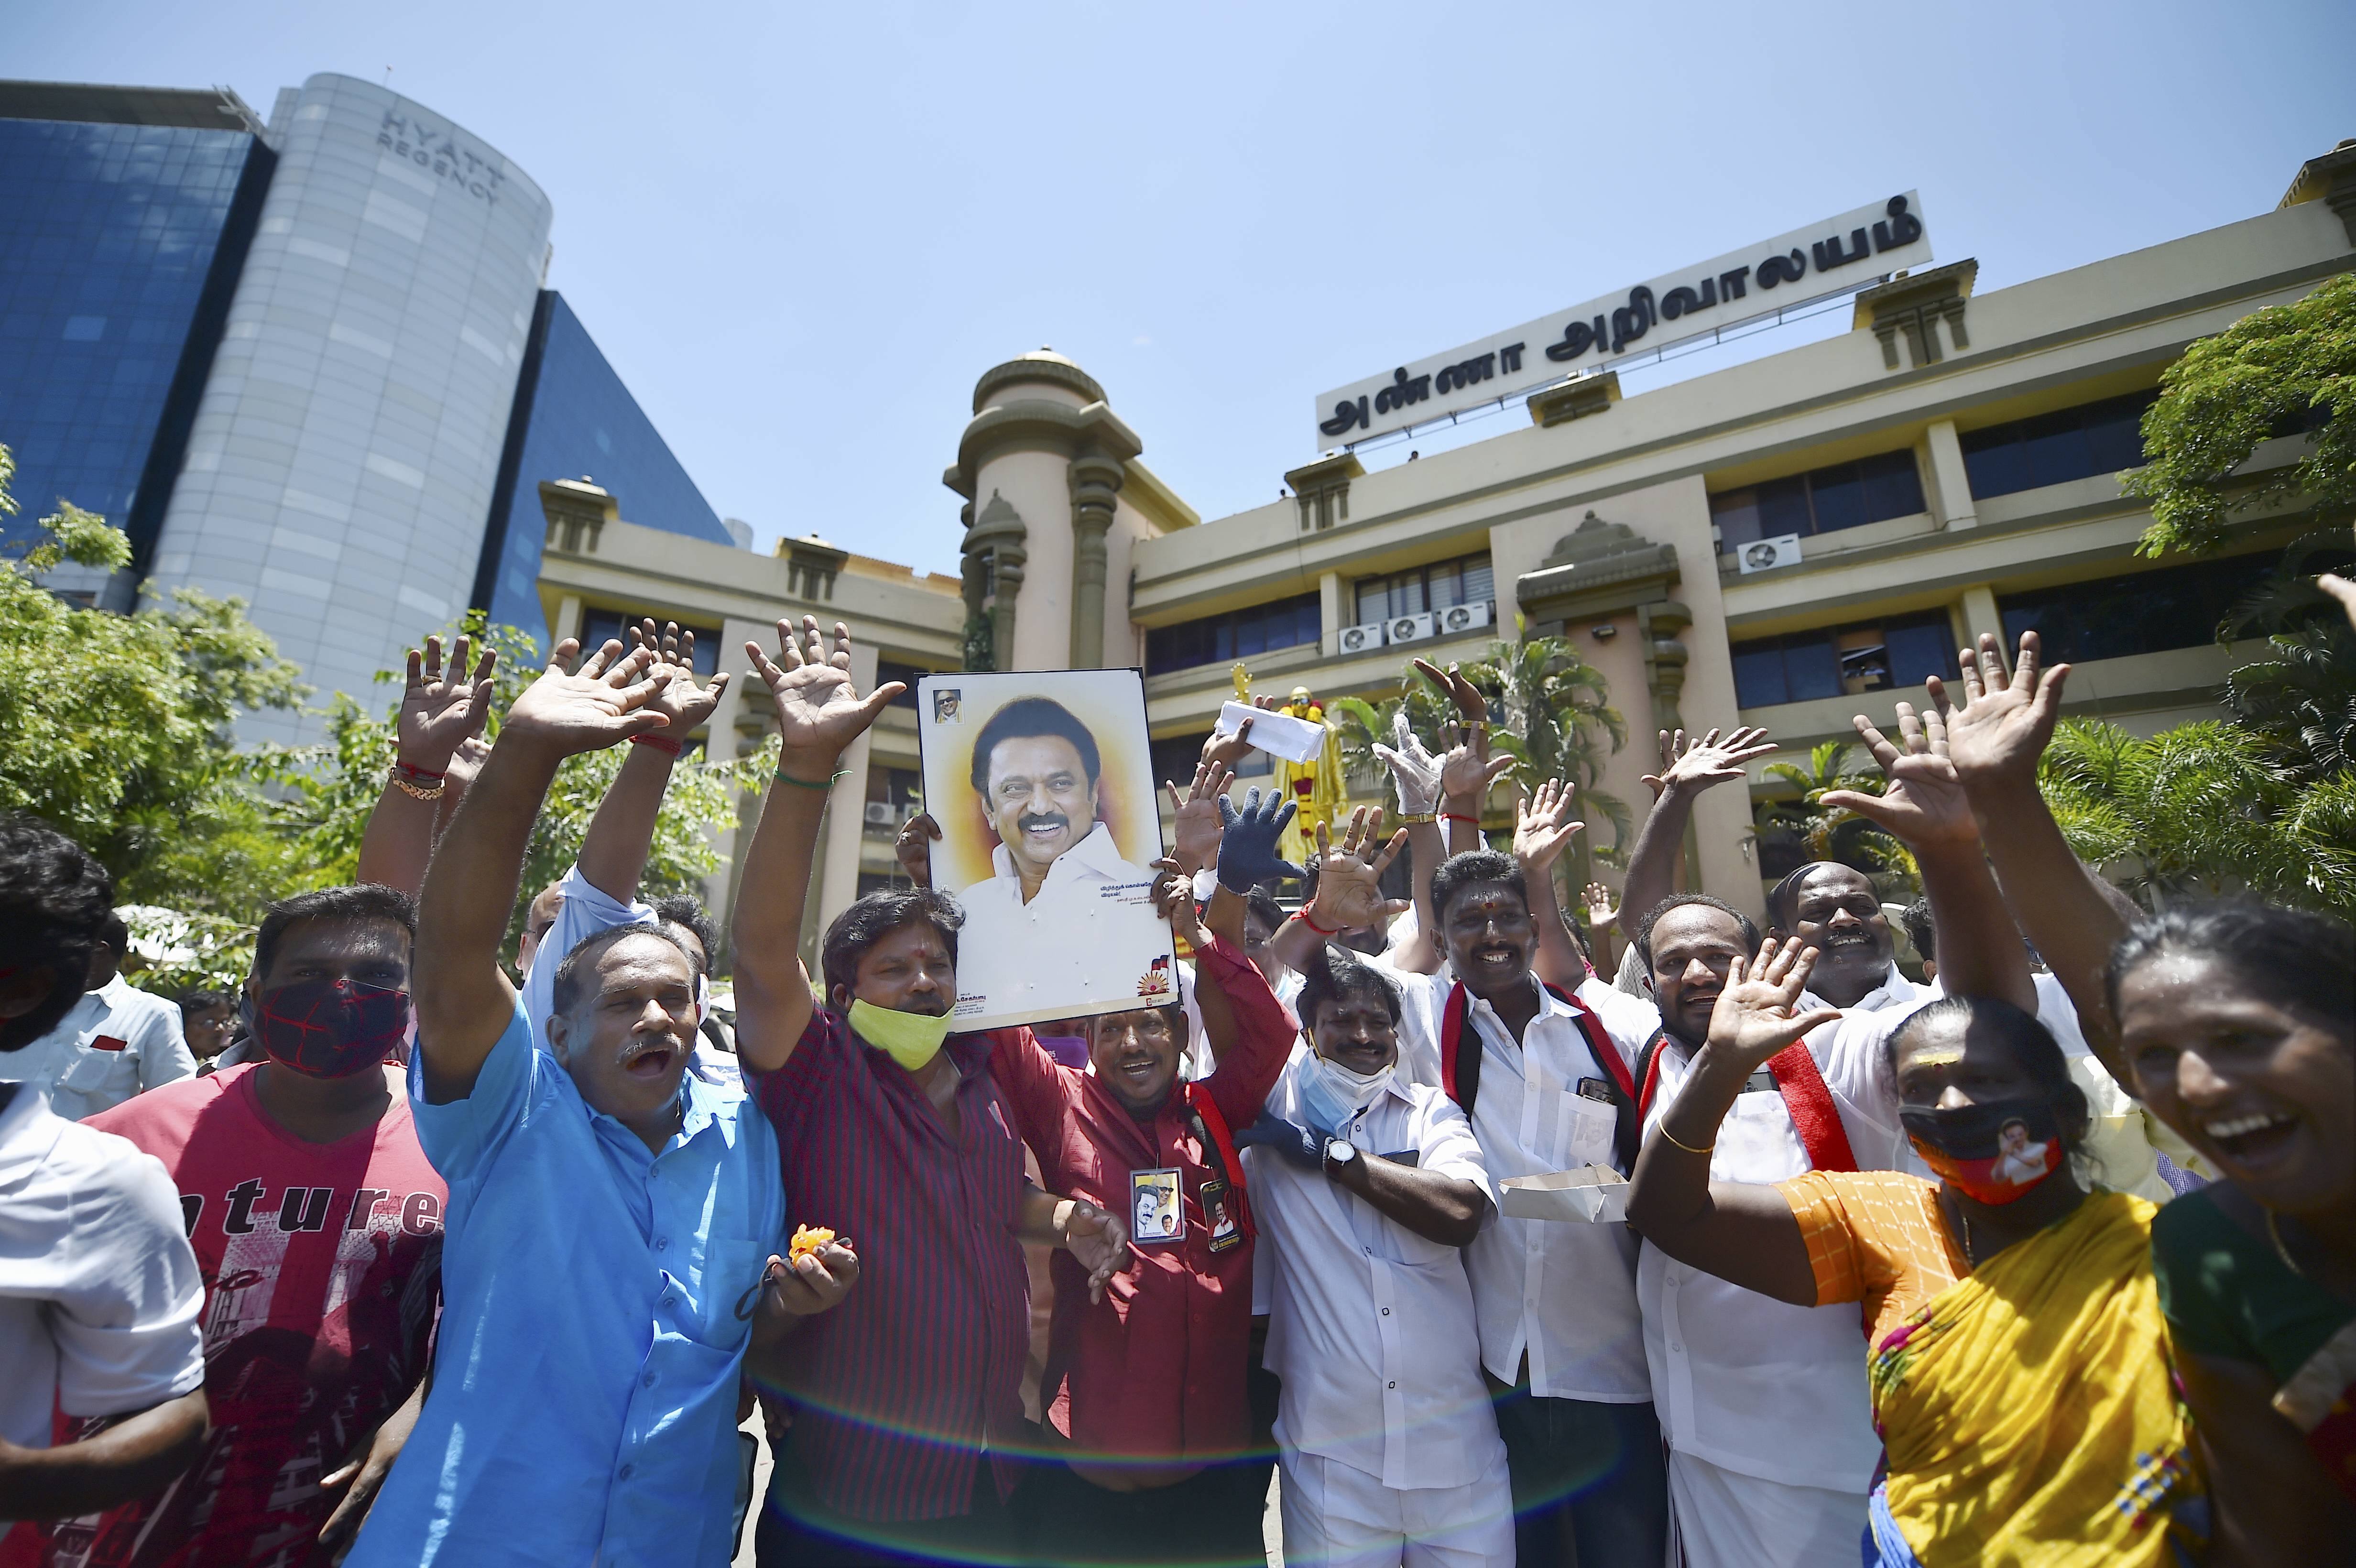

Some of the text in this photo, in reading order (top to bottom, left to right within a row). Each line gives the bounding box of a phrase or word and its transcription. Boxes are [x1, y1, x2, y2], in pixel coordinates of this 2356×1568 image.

[377, 133, 499, 206] REGENCY
[382, 110, 504, 188] HYATT
[1320, 195, 1922, 436] அண்ணா அறிவாலயம்
